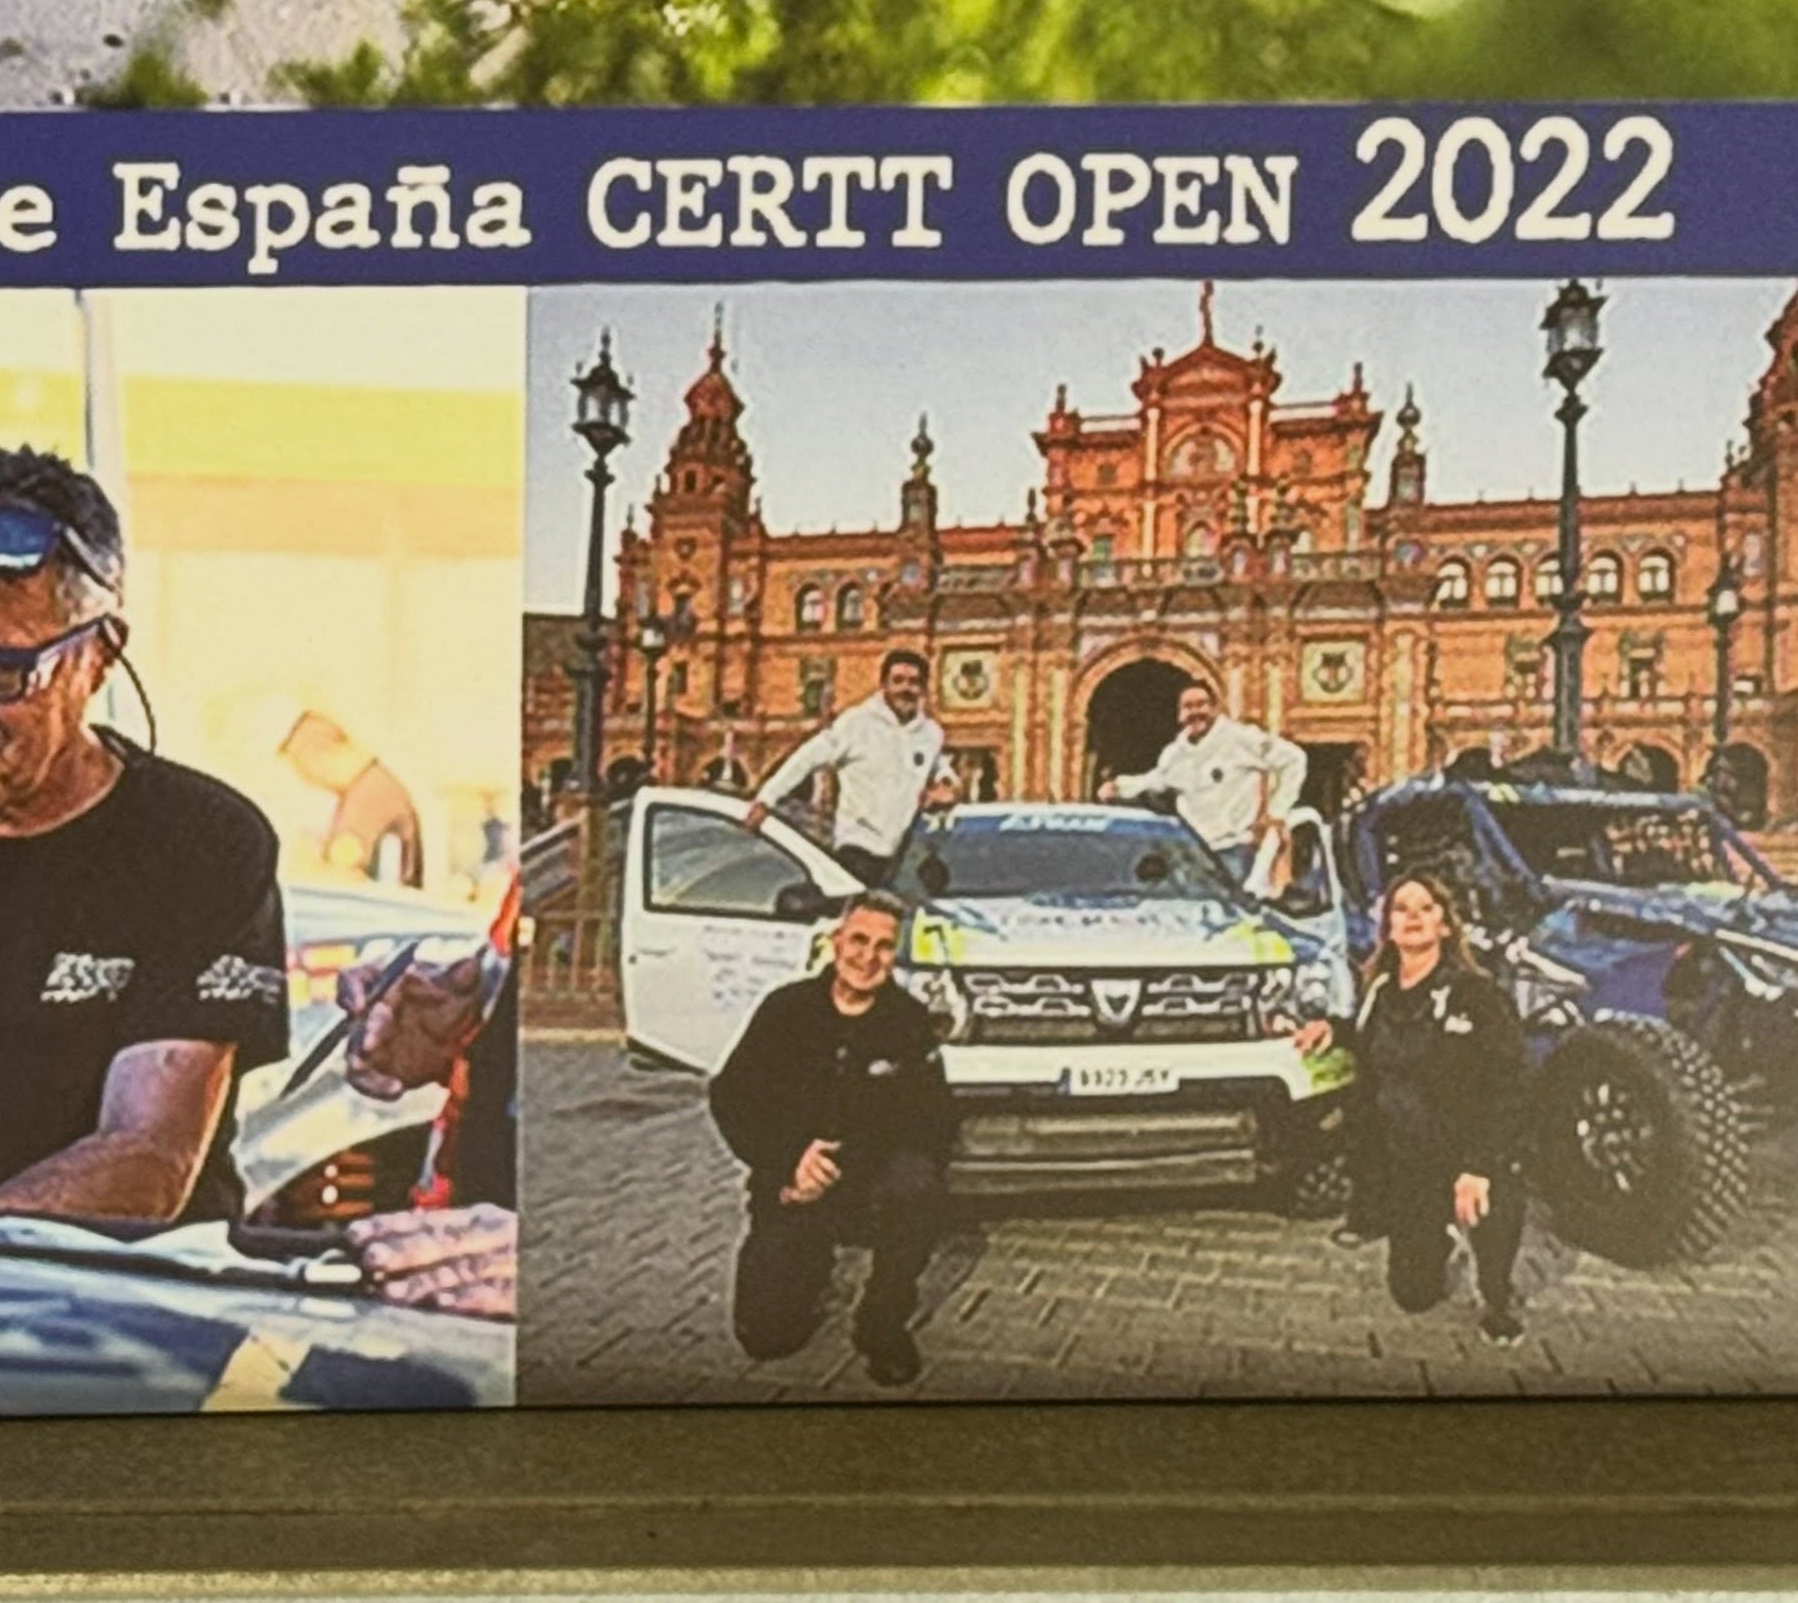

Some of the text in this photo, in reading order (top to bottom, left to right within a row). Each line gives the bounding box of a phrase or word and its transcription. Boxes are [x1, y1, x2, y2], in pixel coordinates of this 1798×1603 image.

[113, 162, 532, 275] España
[587, 155, 953, 249] CERTT
[1007, 152, 1299, 246] OPEN
[1351, 116, 1675, 244] 2022
